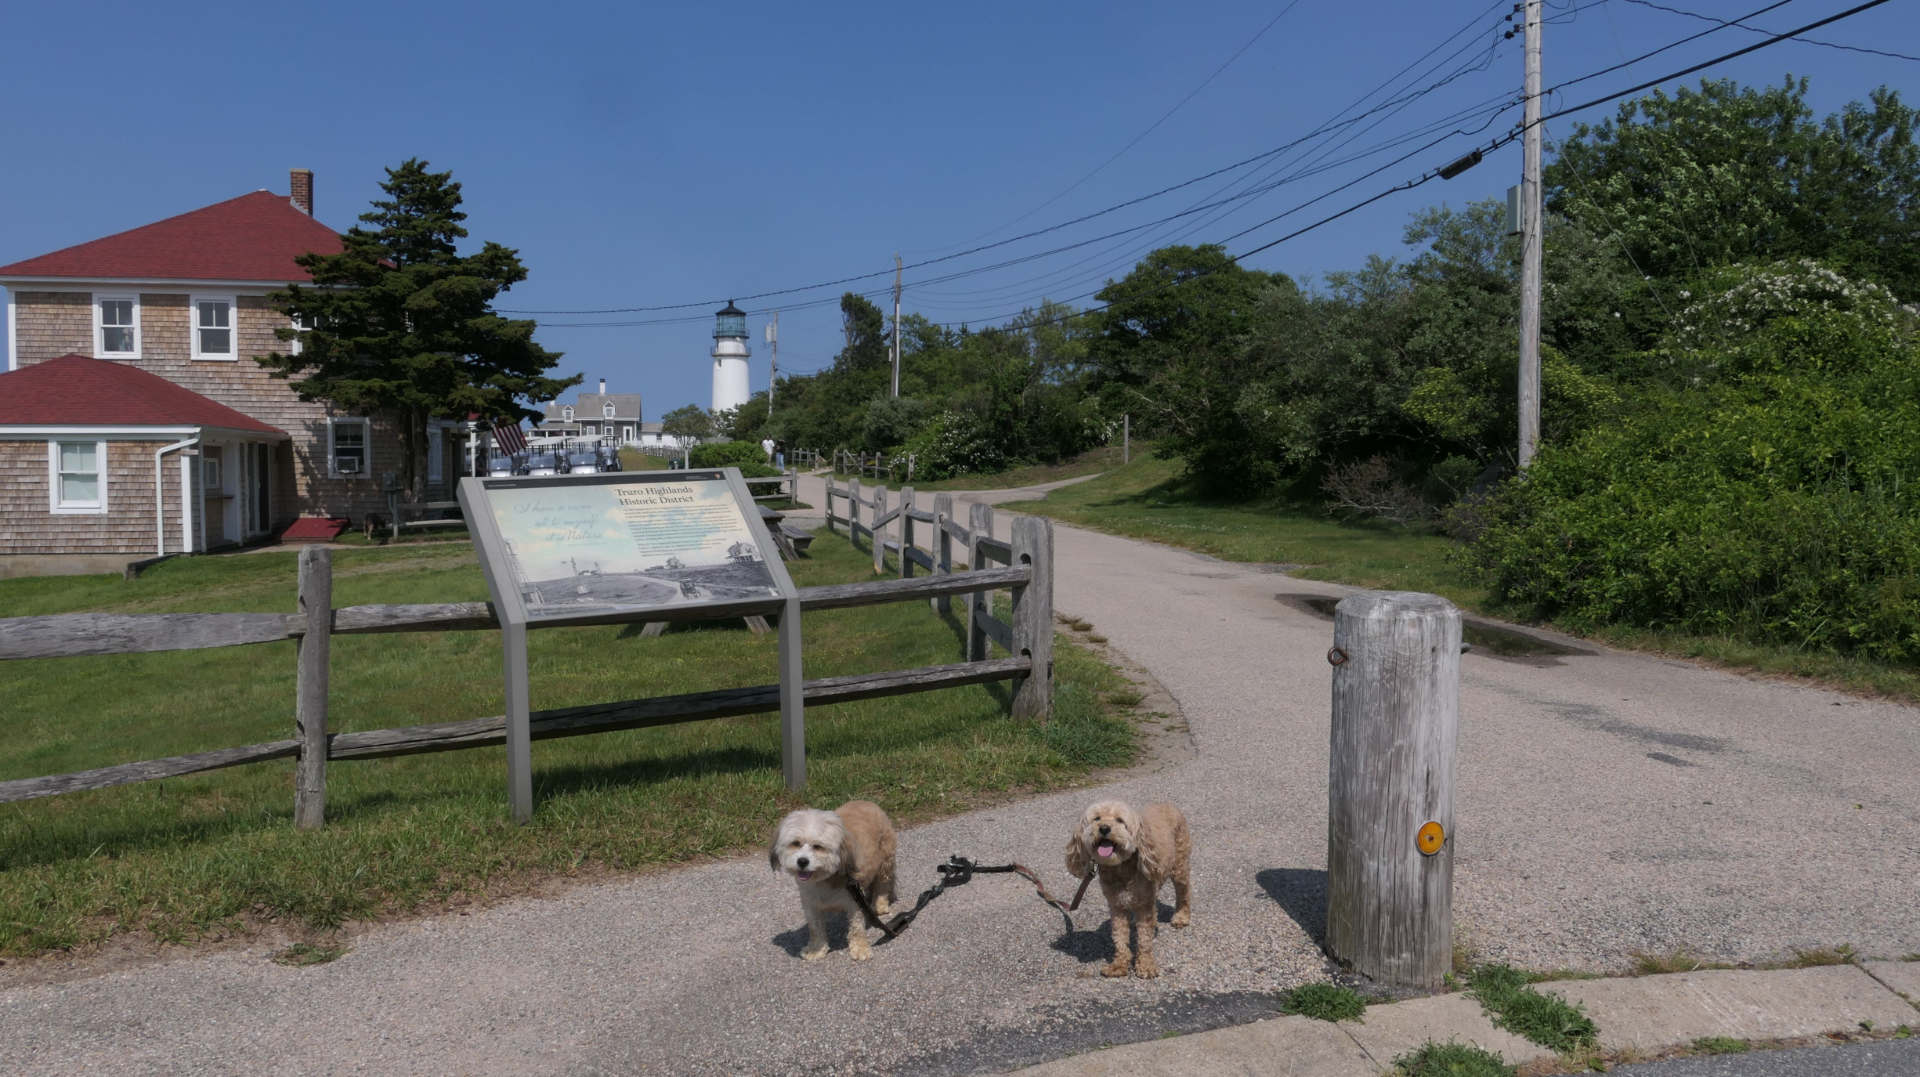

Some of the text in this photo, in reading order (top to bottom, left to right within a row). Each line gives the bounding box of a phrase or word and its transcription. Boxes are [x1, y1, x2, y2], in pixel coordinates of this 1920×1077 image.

[615, 486, 694, 496] Truro Highlands
[619, 496, 694, 505] Historic District
